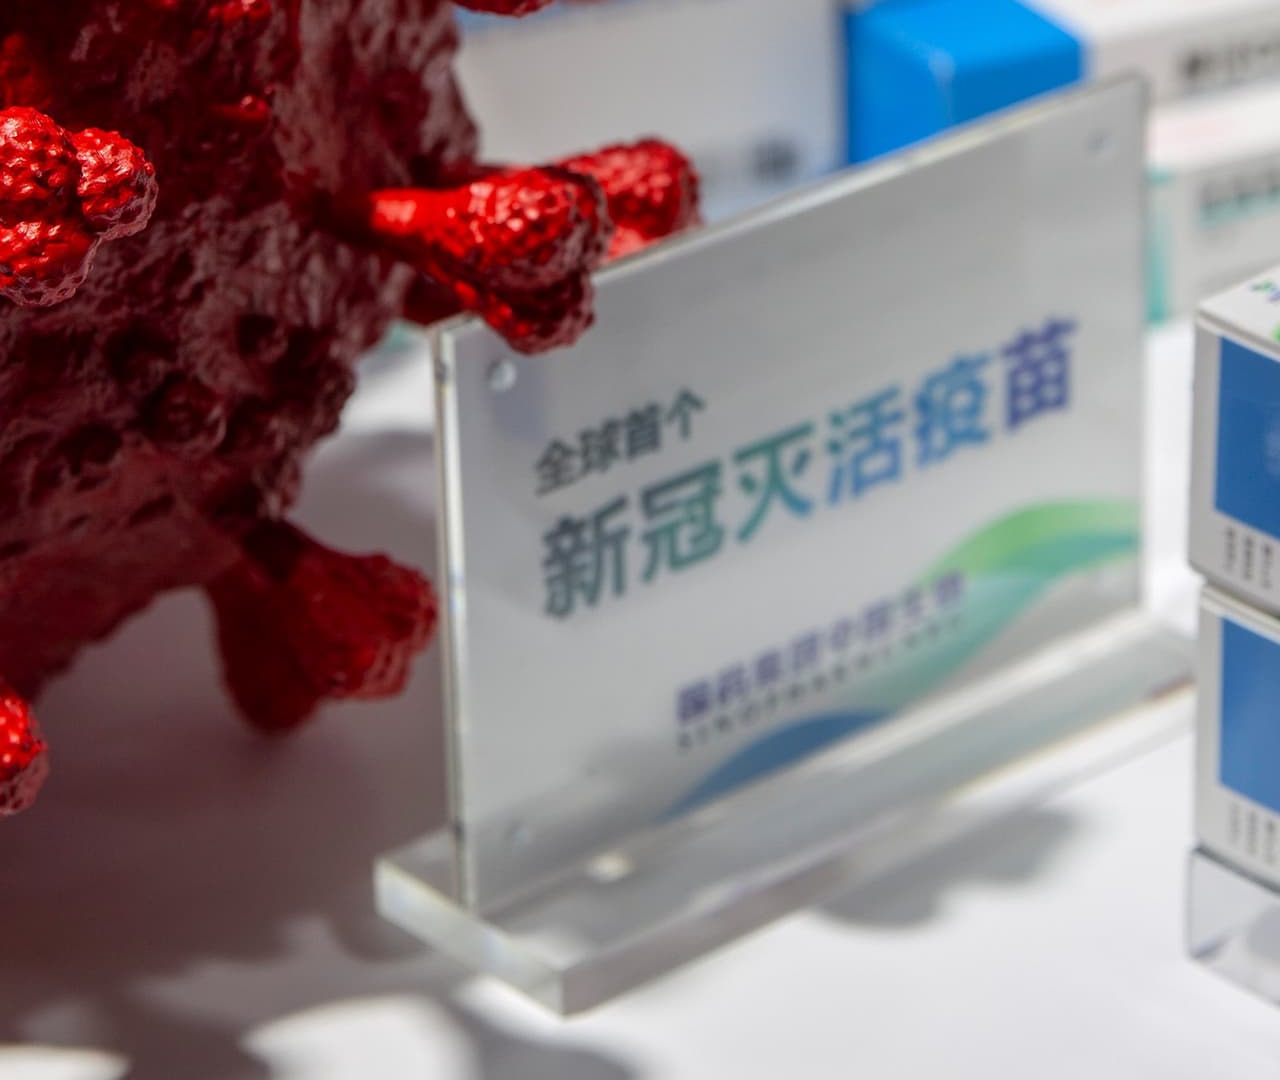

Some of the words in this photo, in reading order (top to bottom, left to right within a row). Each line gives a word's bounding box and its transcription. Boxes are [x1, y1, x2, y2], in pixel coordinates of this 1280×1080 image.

[534, 389, 705, 497] 全球首个
[540, 315, 1078, 622] 新冠灭活疫苗
